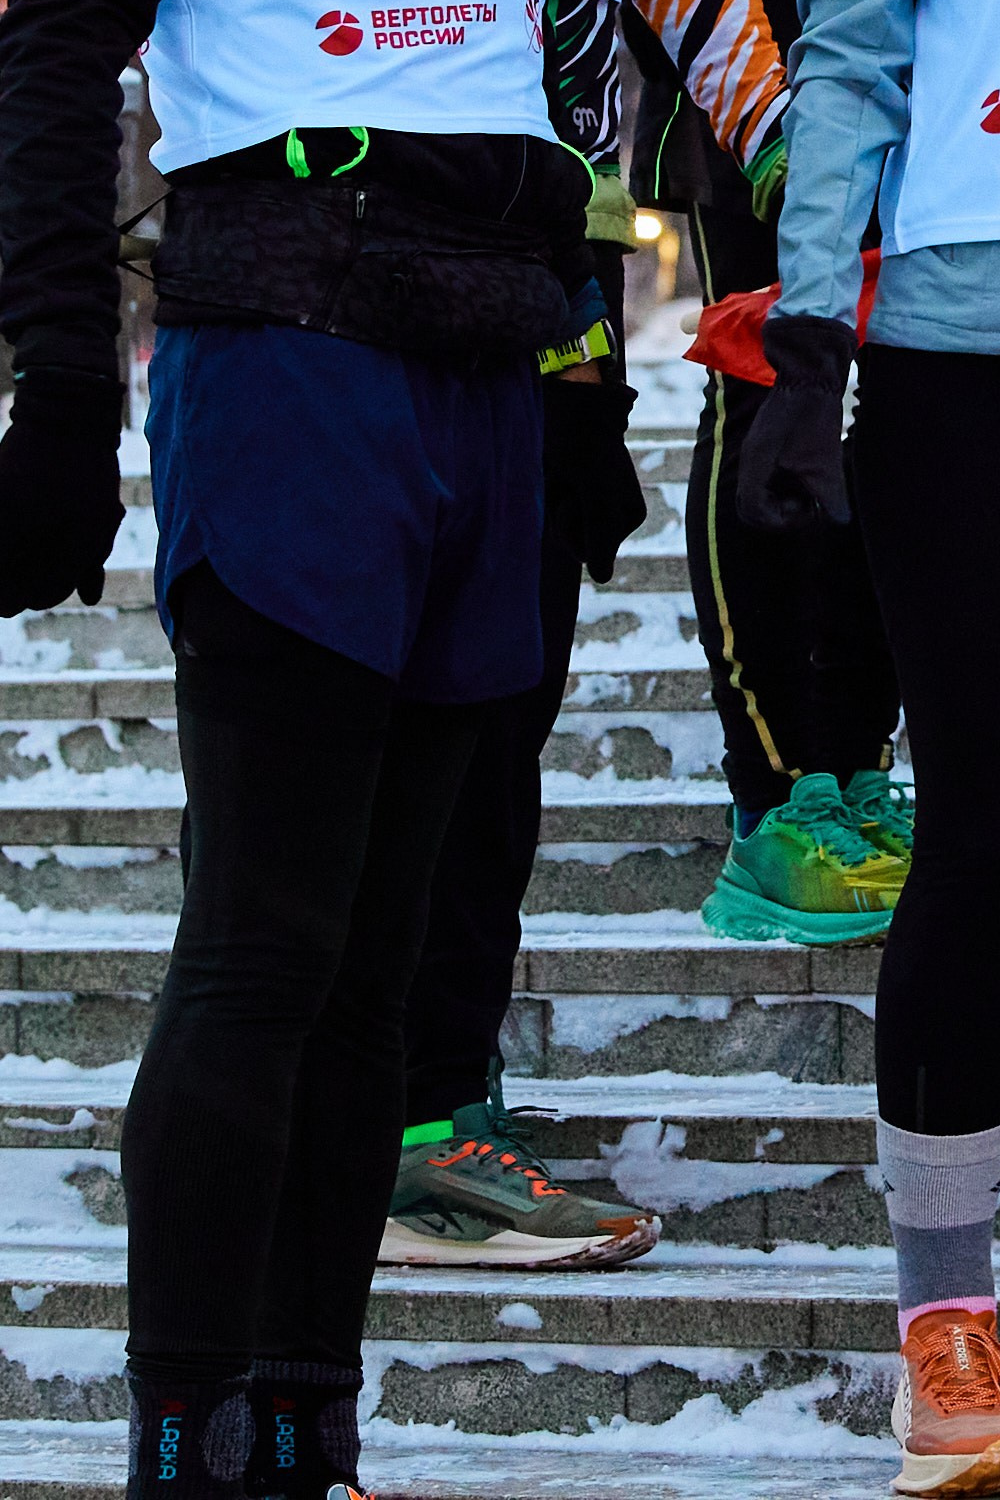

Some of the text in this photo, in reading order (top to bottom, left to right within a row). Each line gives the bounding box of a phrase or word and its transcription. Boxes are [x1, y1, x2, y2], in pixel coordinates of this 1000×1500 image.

[371, 3, 497, 29] ВЕРТОЛЕТЫ
[373, 25, 466, 50] РОССИИ
[954, 1335, 970, 1370] TERREX
